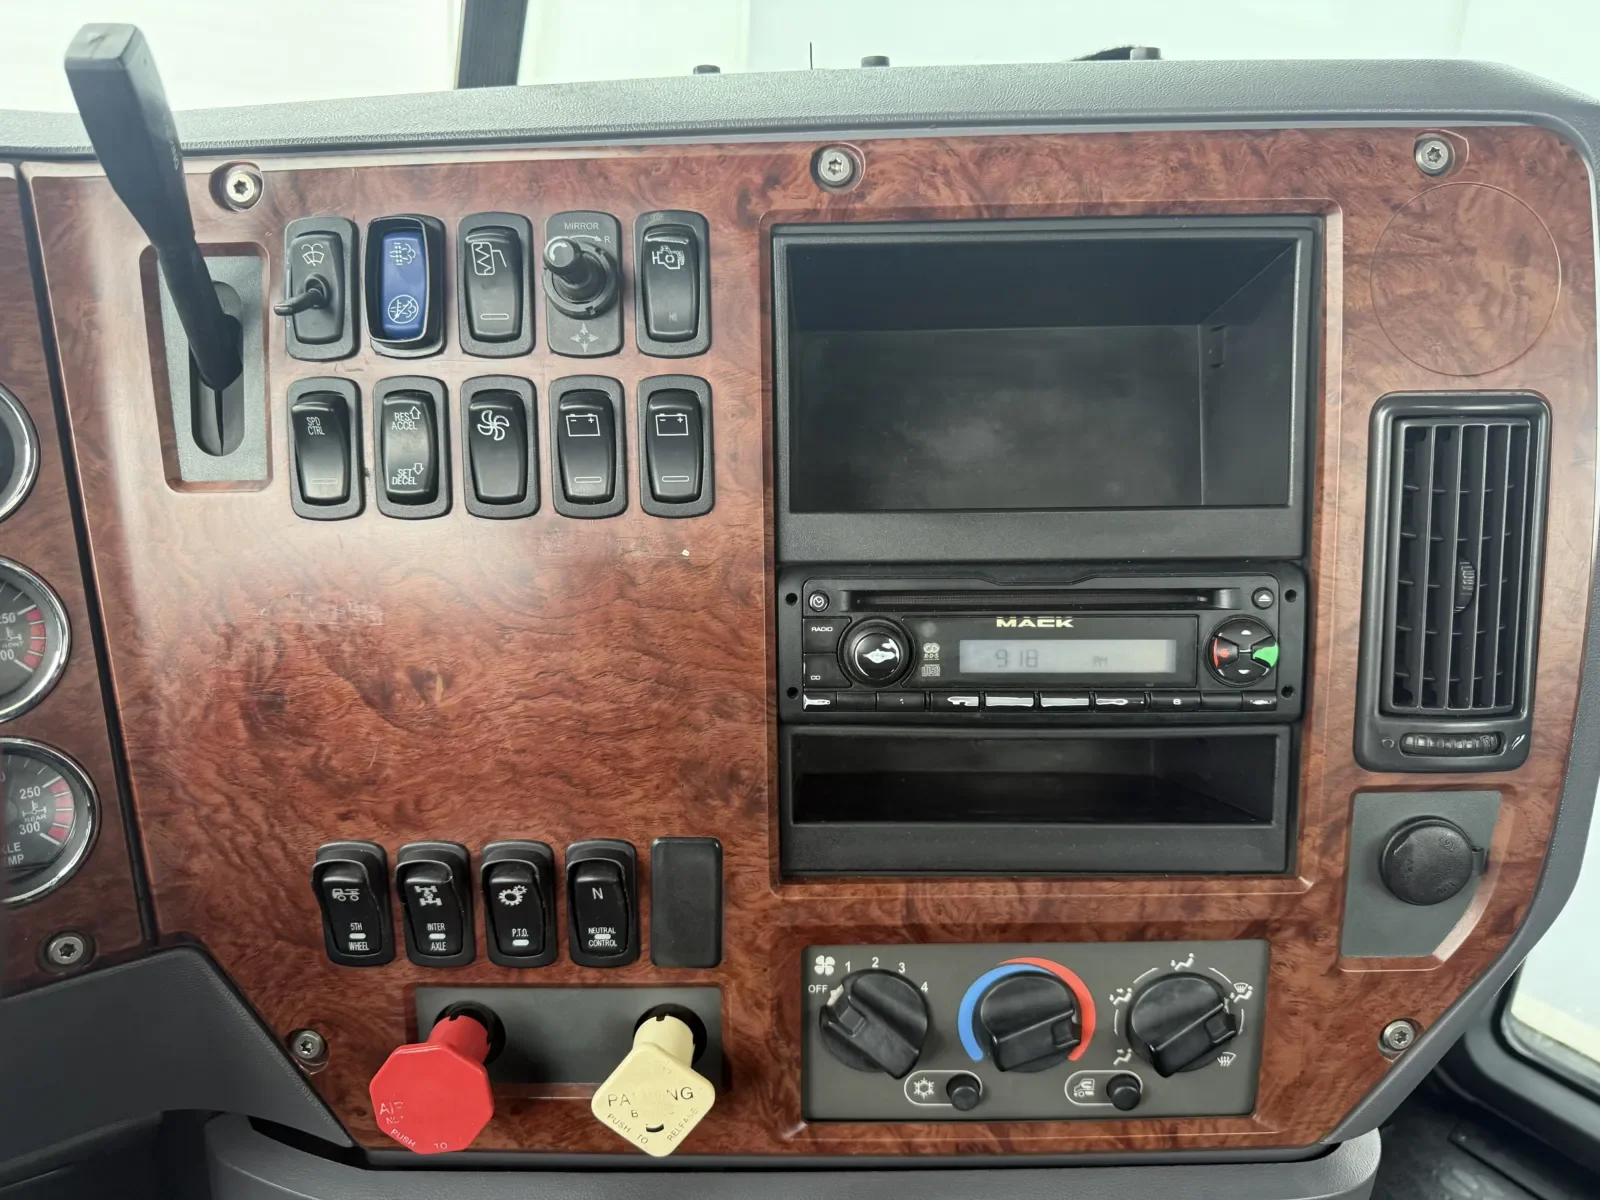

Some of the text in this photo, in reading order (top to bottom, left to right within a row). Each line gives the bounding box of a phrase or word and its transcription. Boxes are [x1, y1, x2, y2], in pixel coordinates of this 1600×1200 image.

[564, 222, 599, 230] MIRROR
[604, 236, 611, 244] R
[306, 416, 321, 426] SPD
[391, 421, 418, 430] ACCEL
[308, 426, 325, 436] CTRL
[397, 468, 412, 478] SET
[392, 477, 417, 485] DECEL
[0, 612, 16, 624] 50
[996, 616, 1074, 628] MACK
[0, 649, 15, 661] 00
[19, 786, 41, 800] 250
[24, 814, 47, 823] REAR
[19, 821, 41, 835] 300
[592, 887, 604, 899] N
[350, 922, 362, 931] 5TH
[427, 922, 445, 931] INTER
[348, 942, 369, 951] WHEEL
[430, 942, 447, 951] AXLE
[588, 939, 618, 947] CONTROL
[845, 956, 929, 993] 1 2 3 4
[807, 984, 828, 993] OFF
[607, 1086, 694, 1107] PANG
[606, 1113, 631, 1133] PUSH
[636, 1133, 649, 1145] TO
[666, 1107, 699, 1142] RELEAE
[390, 1128, 448, 1150] PUSH TO
